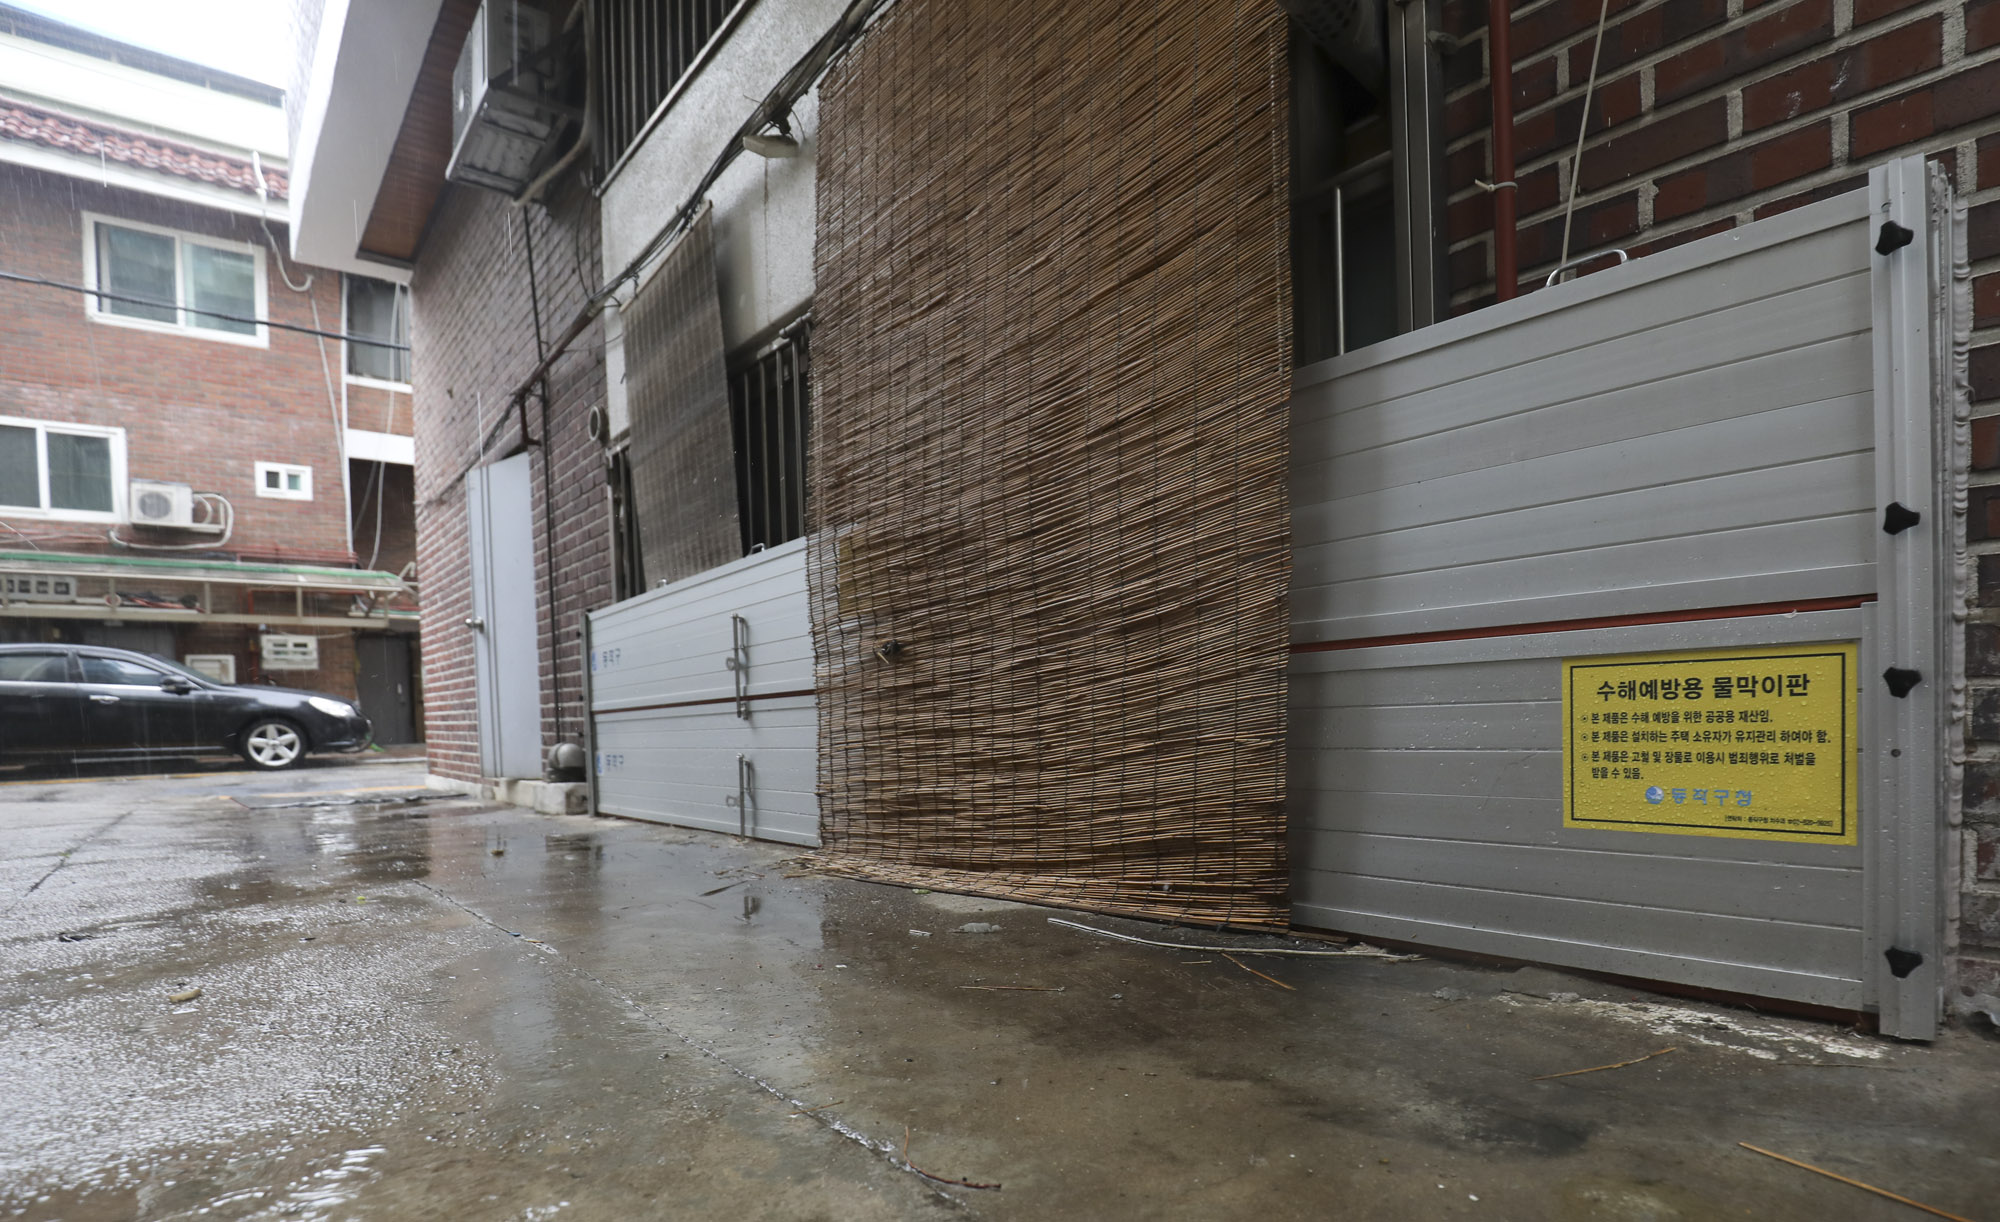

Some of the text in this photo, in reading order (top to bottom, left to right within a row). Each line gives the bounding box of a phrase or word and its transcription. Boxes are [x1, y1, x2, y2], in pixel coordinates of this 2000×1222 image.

[1597, 673, 1811, 701] 수해예방용 물막이판
[1591, 709, 1773, 724] 본 제품은 수해 예방을 위한 공공용 재산임.
[1591, 729, 1832, 743] 본 제품은 설치하는 주택 소유자가 유지관리 하여야 함.
[1591, 751, 1816, 766] 본 제품은 고철 및 장물로 이용시 범죄행위로 처벌을
[1591, 767, 1644, 780] 받을 수 있음.
[1671, 787, 1752, 807] 동작구청
